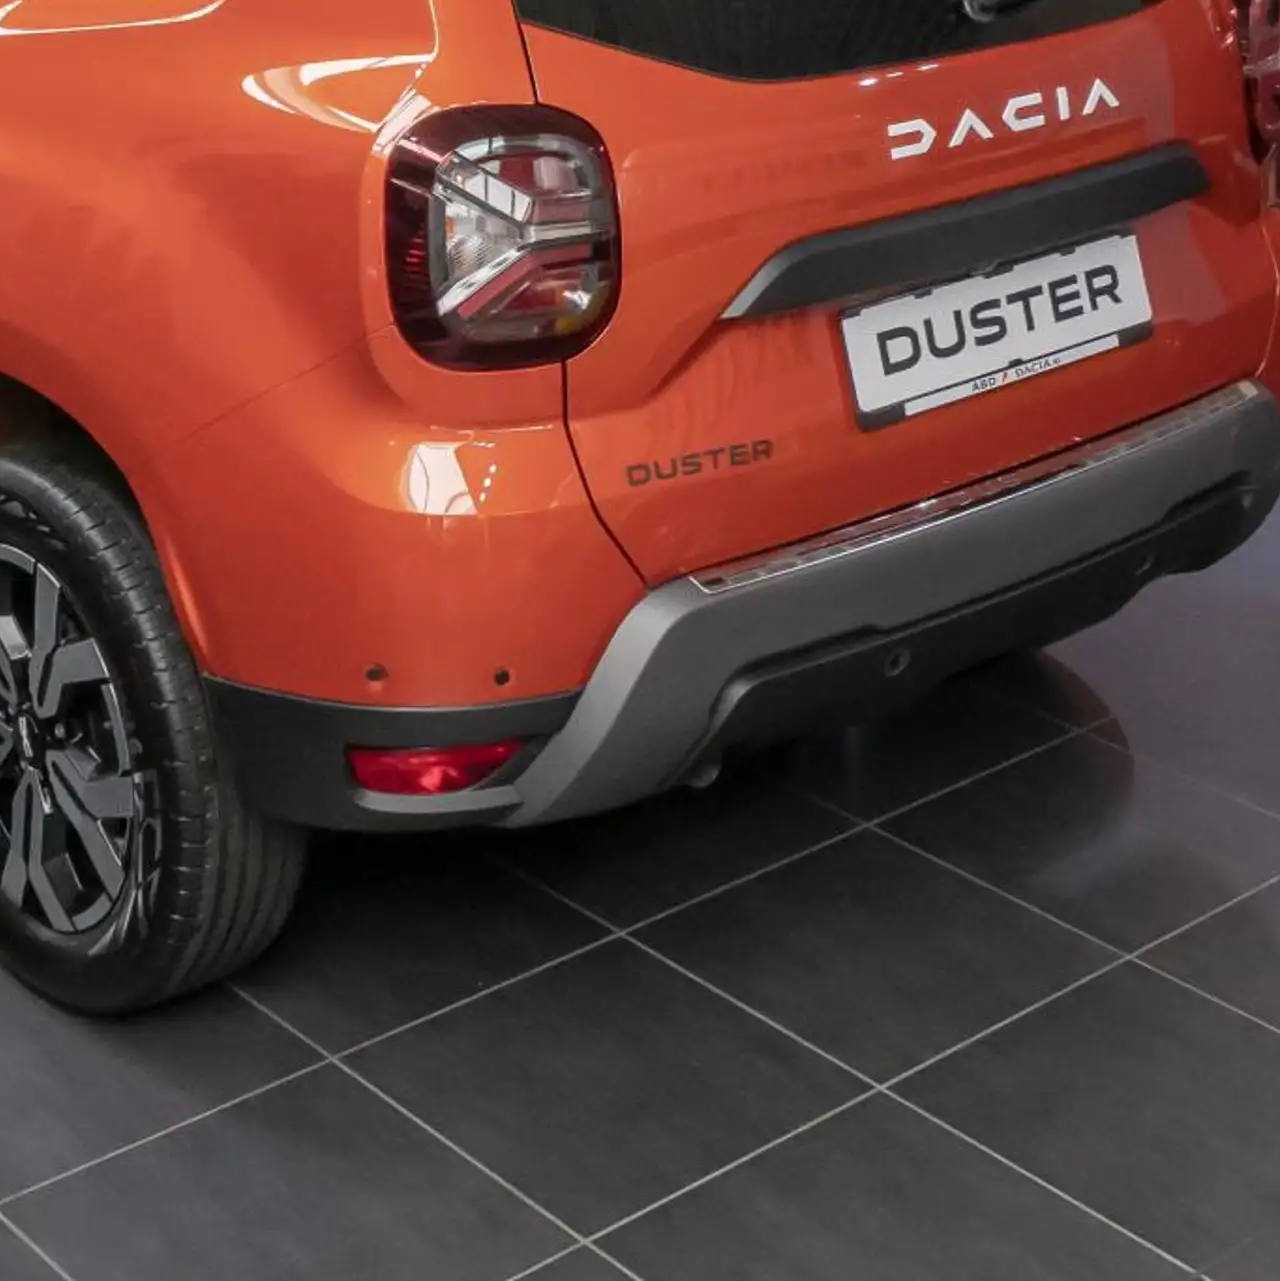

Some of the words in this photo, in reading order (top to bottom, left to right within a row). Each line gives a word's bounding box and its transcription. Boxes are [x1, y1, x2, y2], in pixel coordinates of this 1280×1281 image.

[887, 78, 1120, 161] DACIA
[876, 263, 1122, 377] DUSTER
[1015, 359, 1051, 378] DACIA
[626, 438, 775, 487] DUSTER
